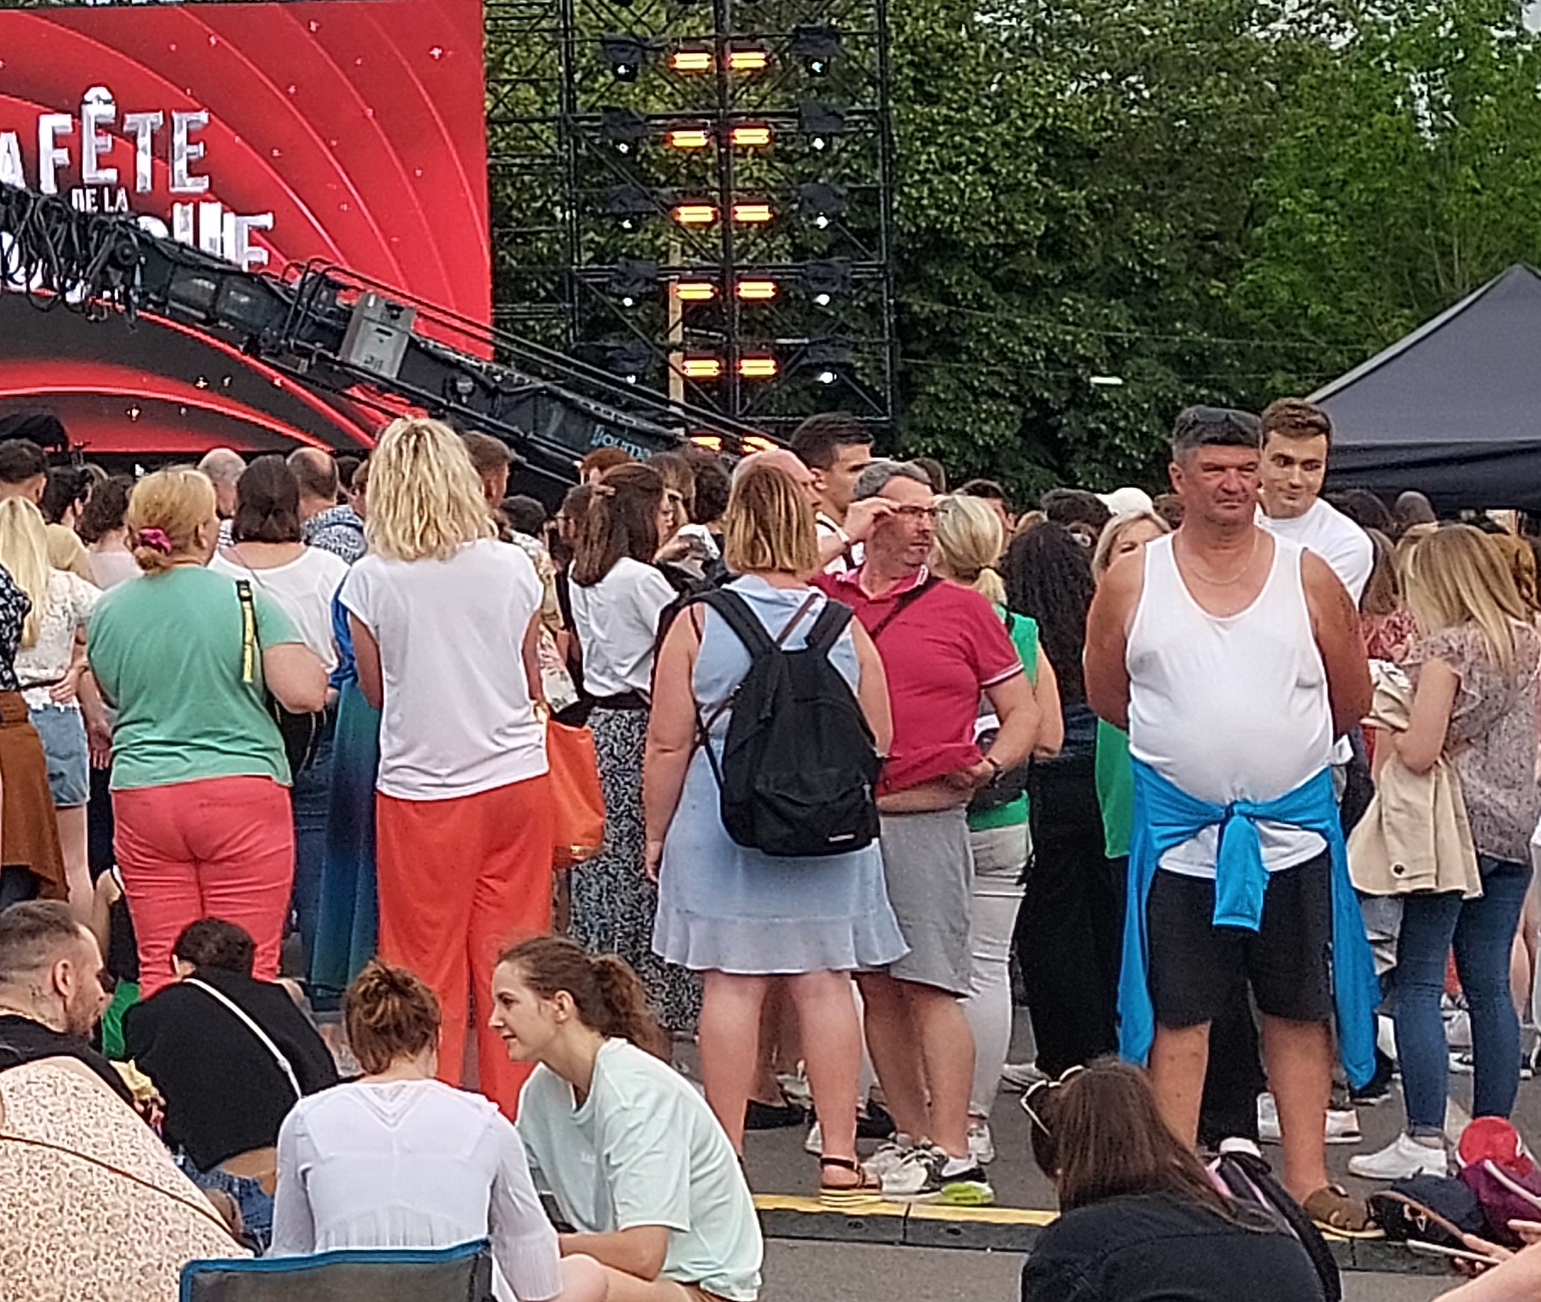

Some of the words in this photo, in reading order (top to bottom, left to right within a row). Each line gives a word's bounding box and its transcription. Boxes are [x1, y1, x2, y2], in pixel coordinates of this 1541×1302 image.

[38, 86, 210, 195] FÊTE
[71, 187, 98, 214] DE
[103, 186, 129, 214] LA
